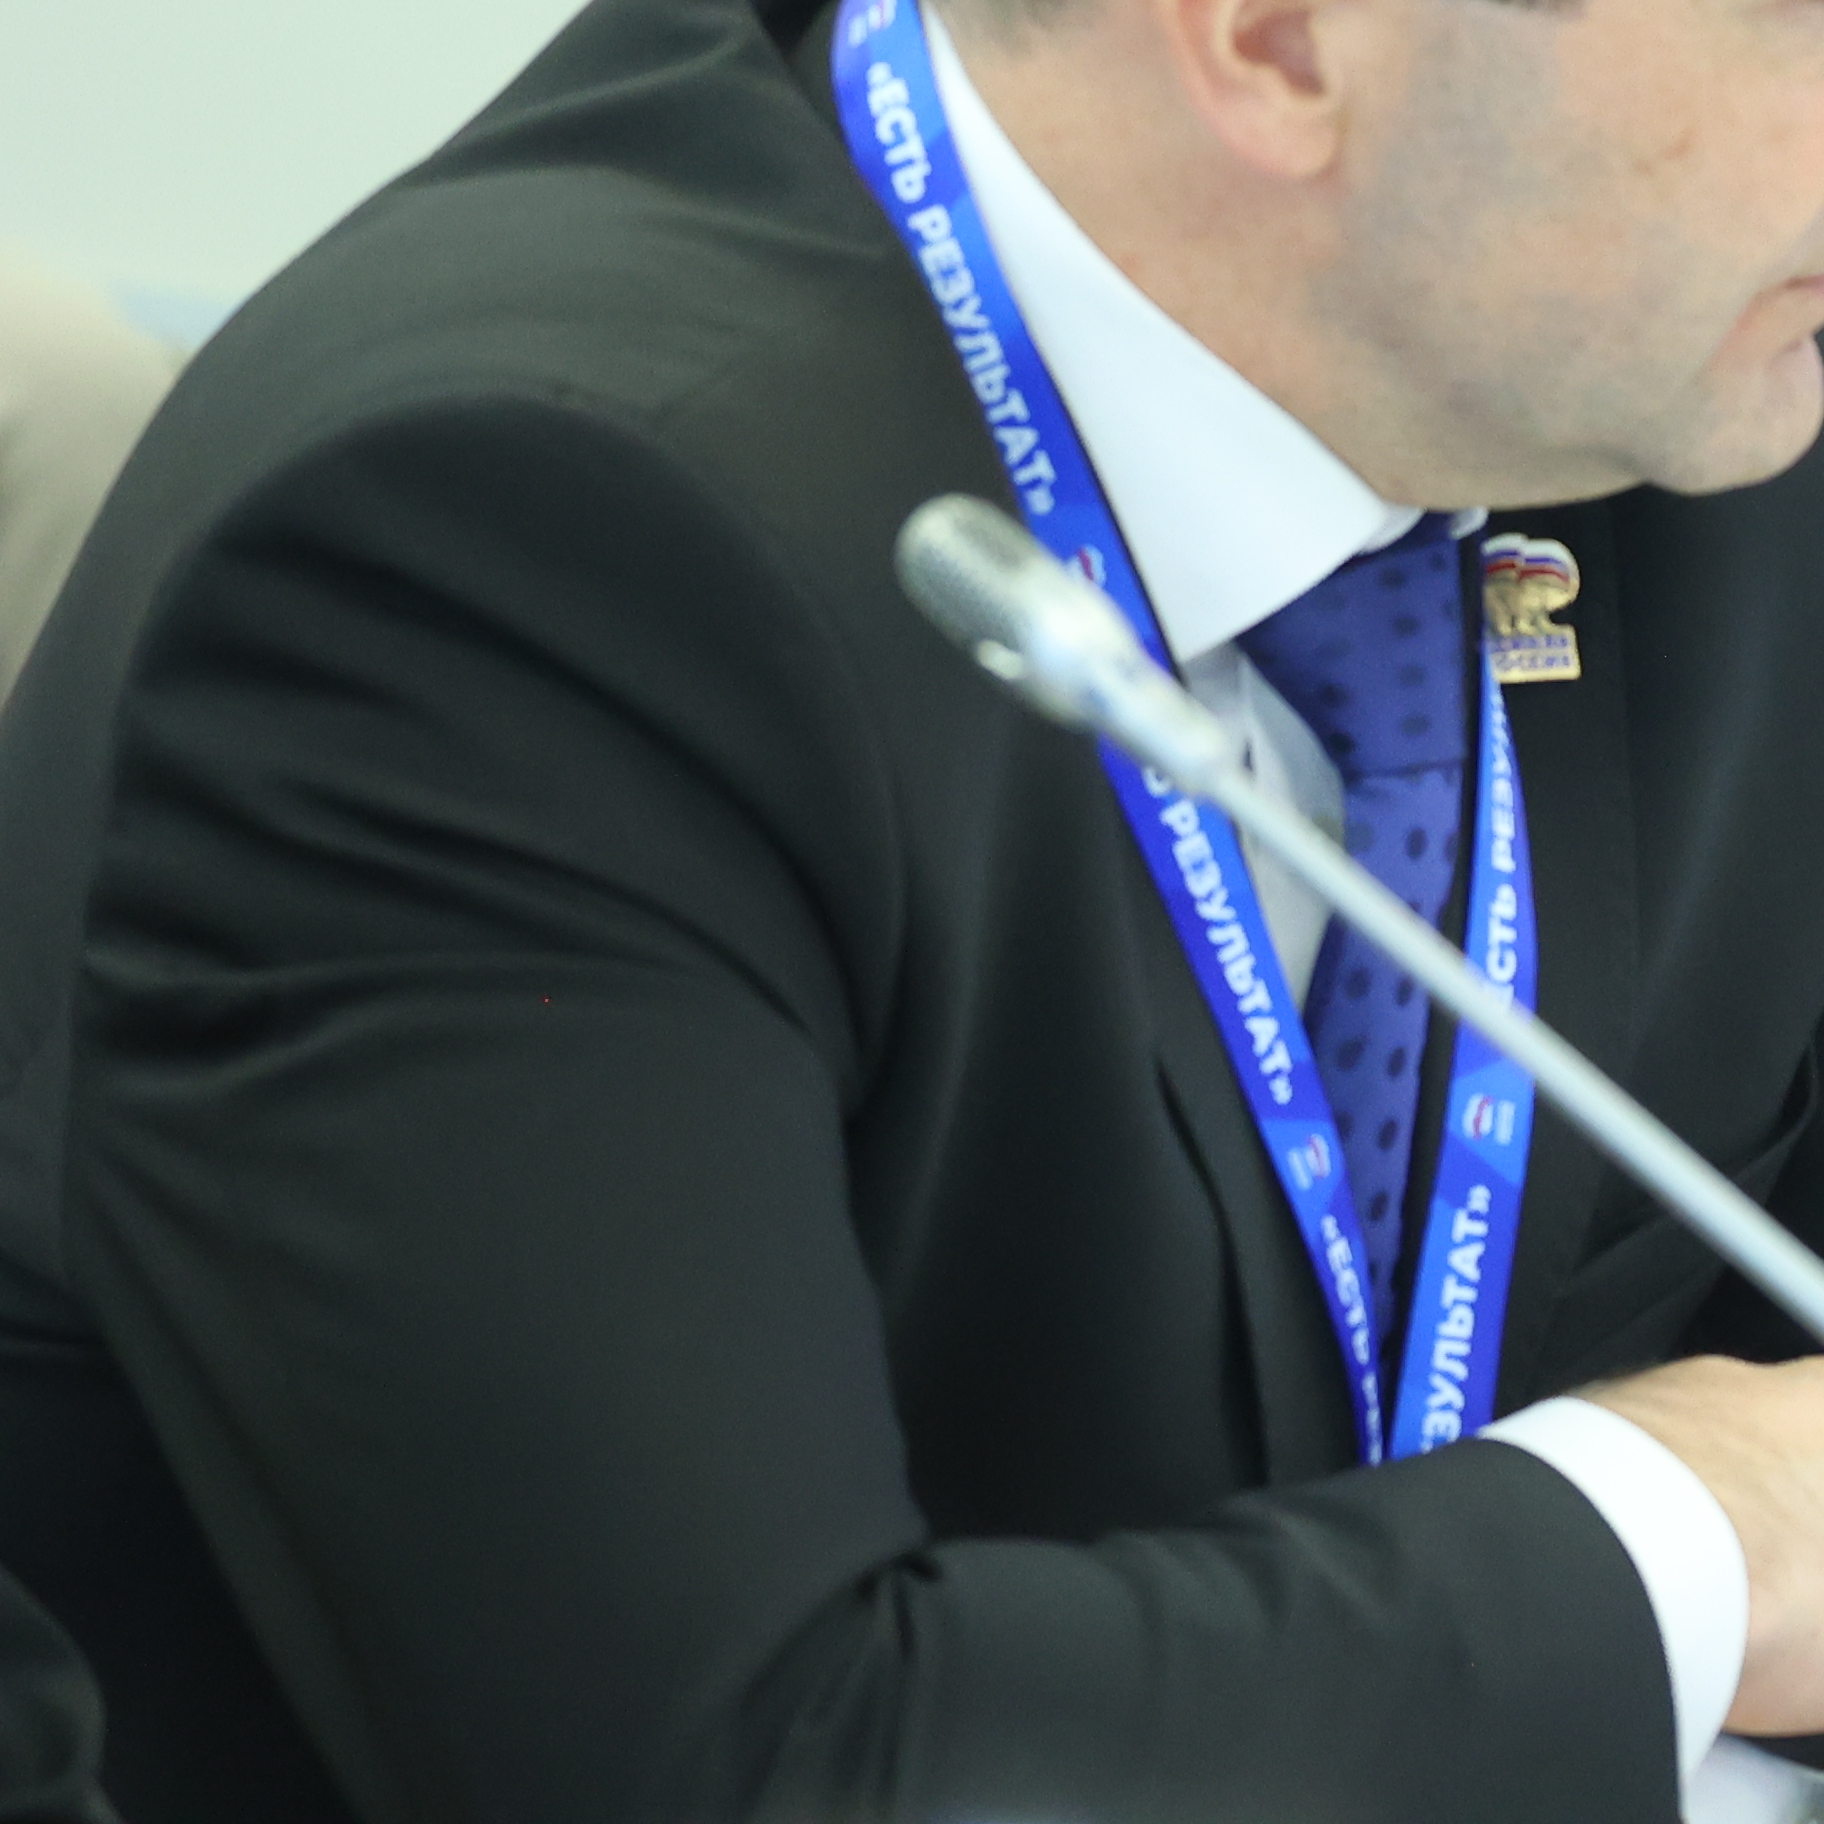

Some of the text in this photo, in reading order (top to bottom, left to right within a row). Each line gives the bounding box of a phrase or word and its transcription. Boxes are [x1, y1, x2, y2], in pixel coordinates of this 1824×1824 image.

[866, 61, 1057, 516] «ЕСТЬ РЕЗУЛЬТАТ»
[1160, 798, 1293, 1106] РЕЗУЛЬТАТ»
[1403, 1183, 1492, 1454] ЗУЛЬТАТ»
